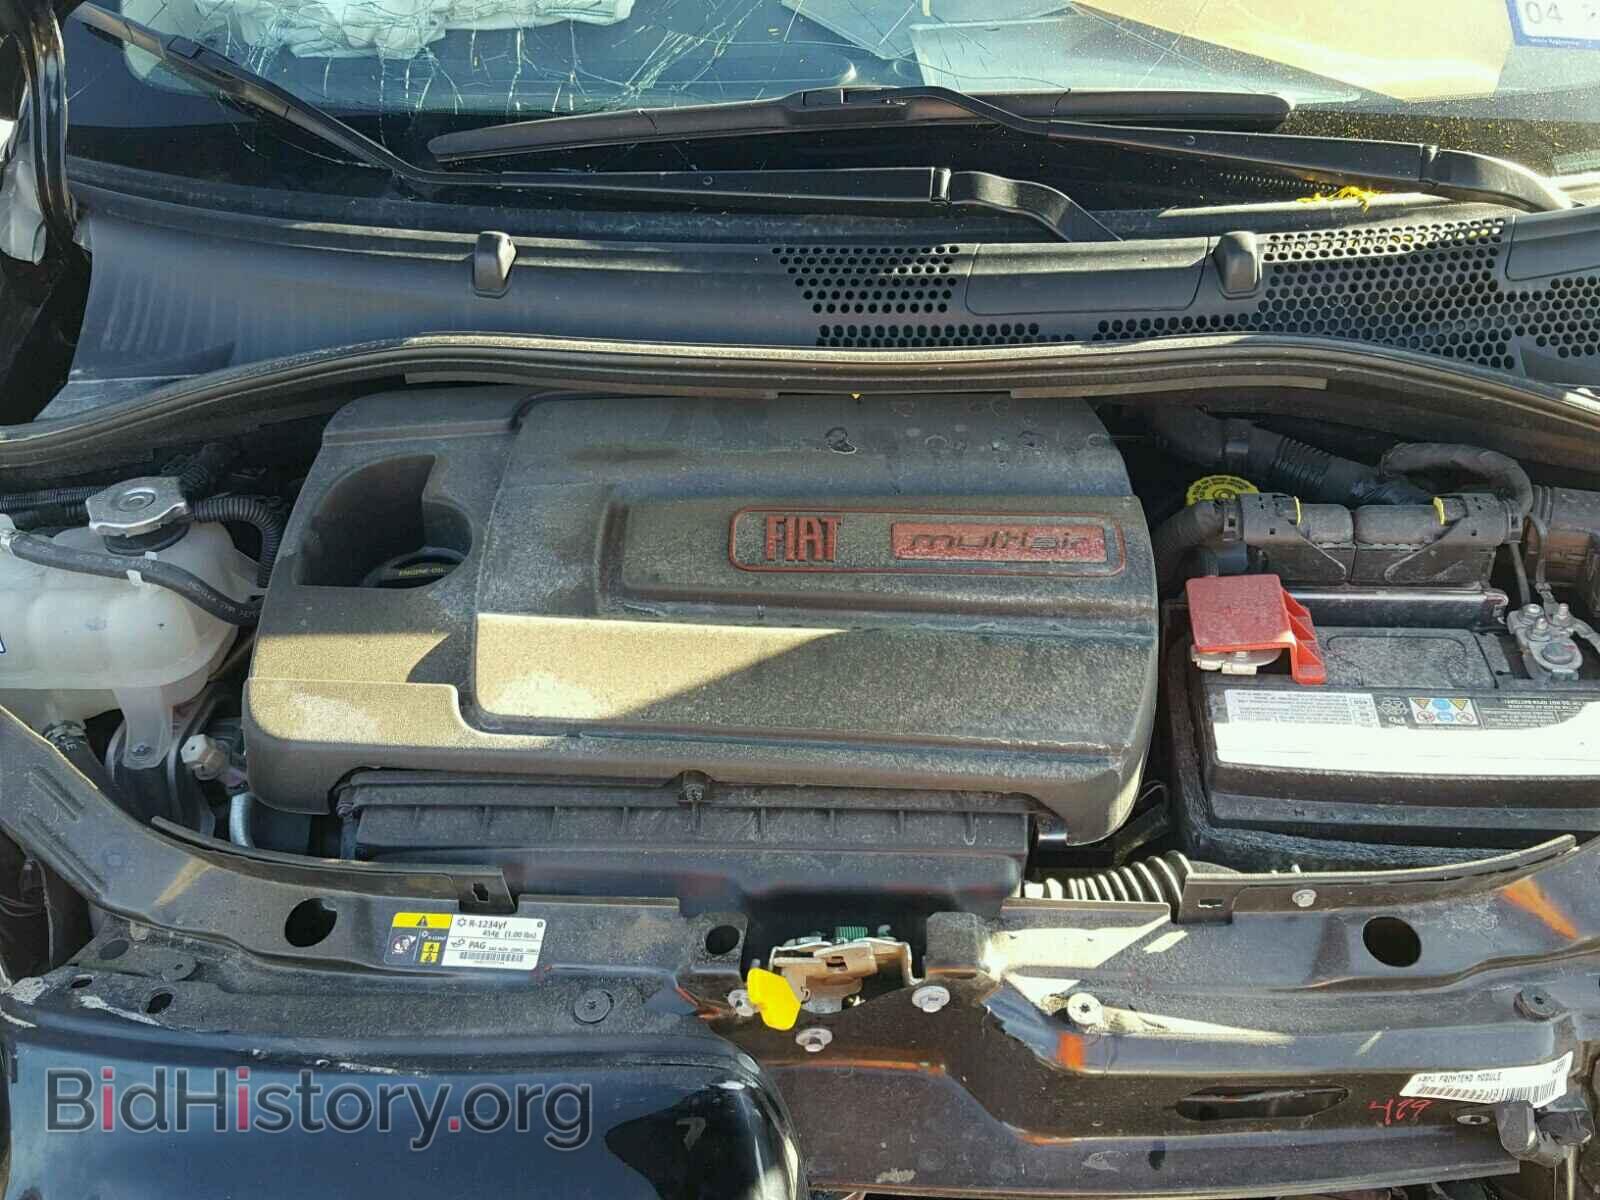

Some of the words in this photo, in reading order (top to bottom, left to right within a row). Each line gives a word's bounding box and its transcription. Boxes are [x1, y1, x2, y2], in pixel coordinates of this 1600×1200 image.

[764, 514, 842, 562] FIAT
[911, 530, 1088, 552] multiair
[468, 920, 508, 930] R-1234yf
[468, 941, 487, 950] PAG
